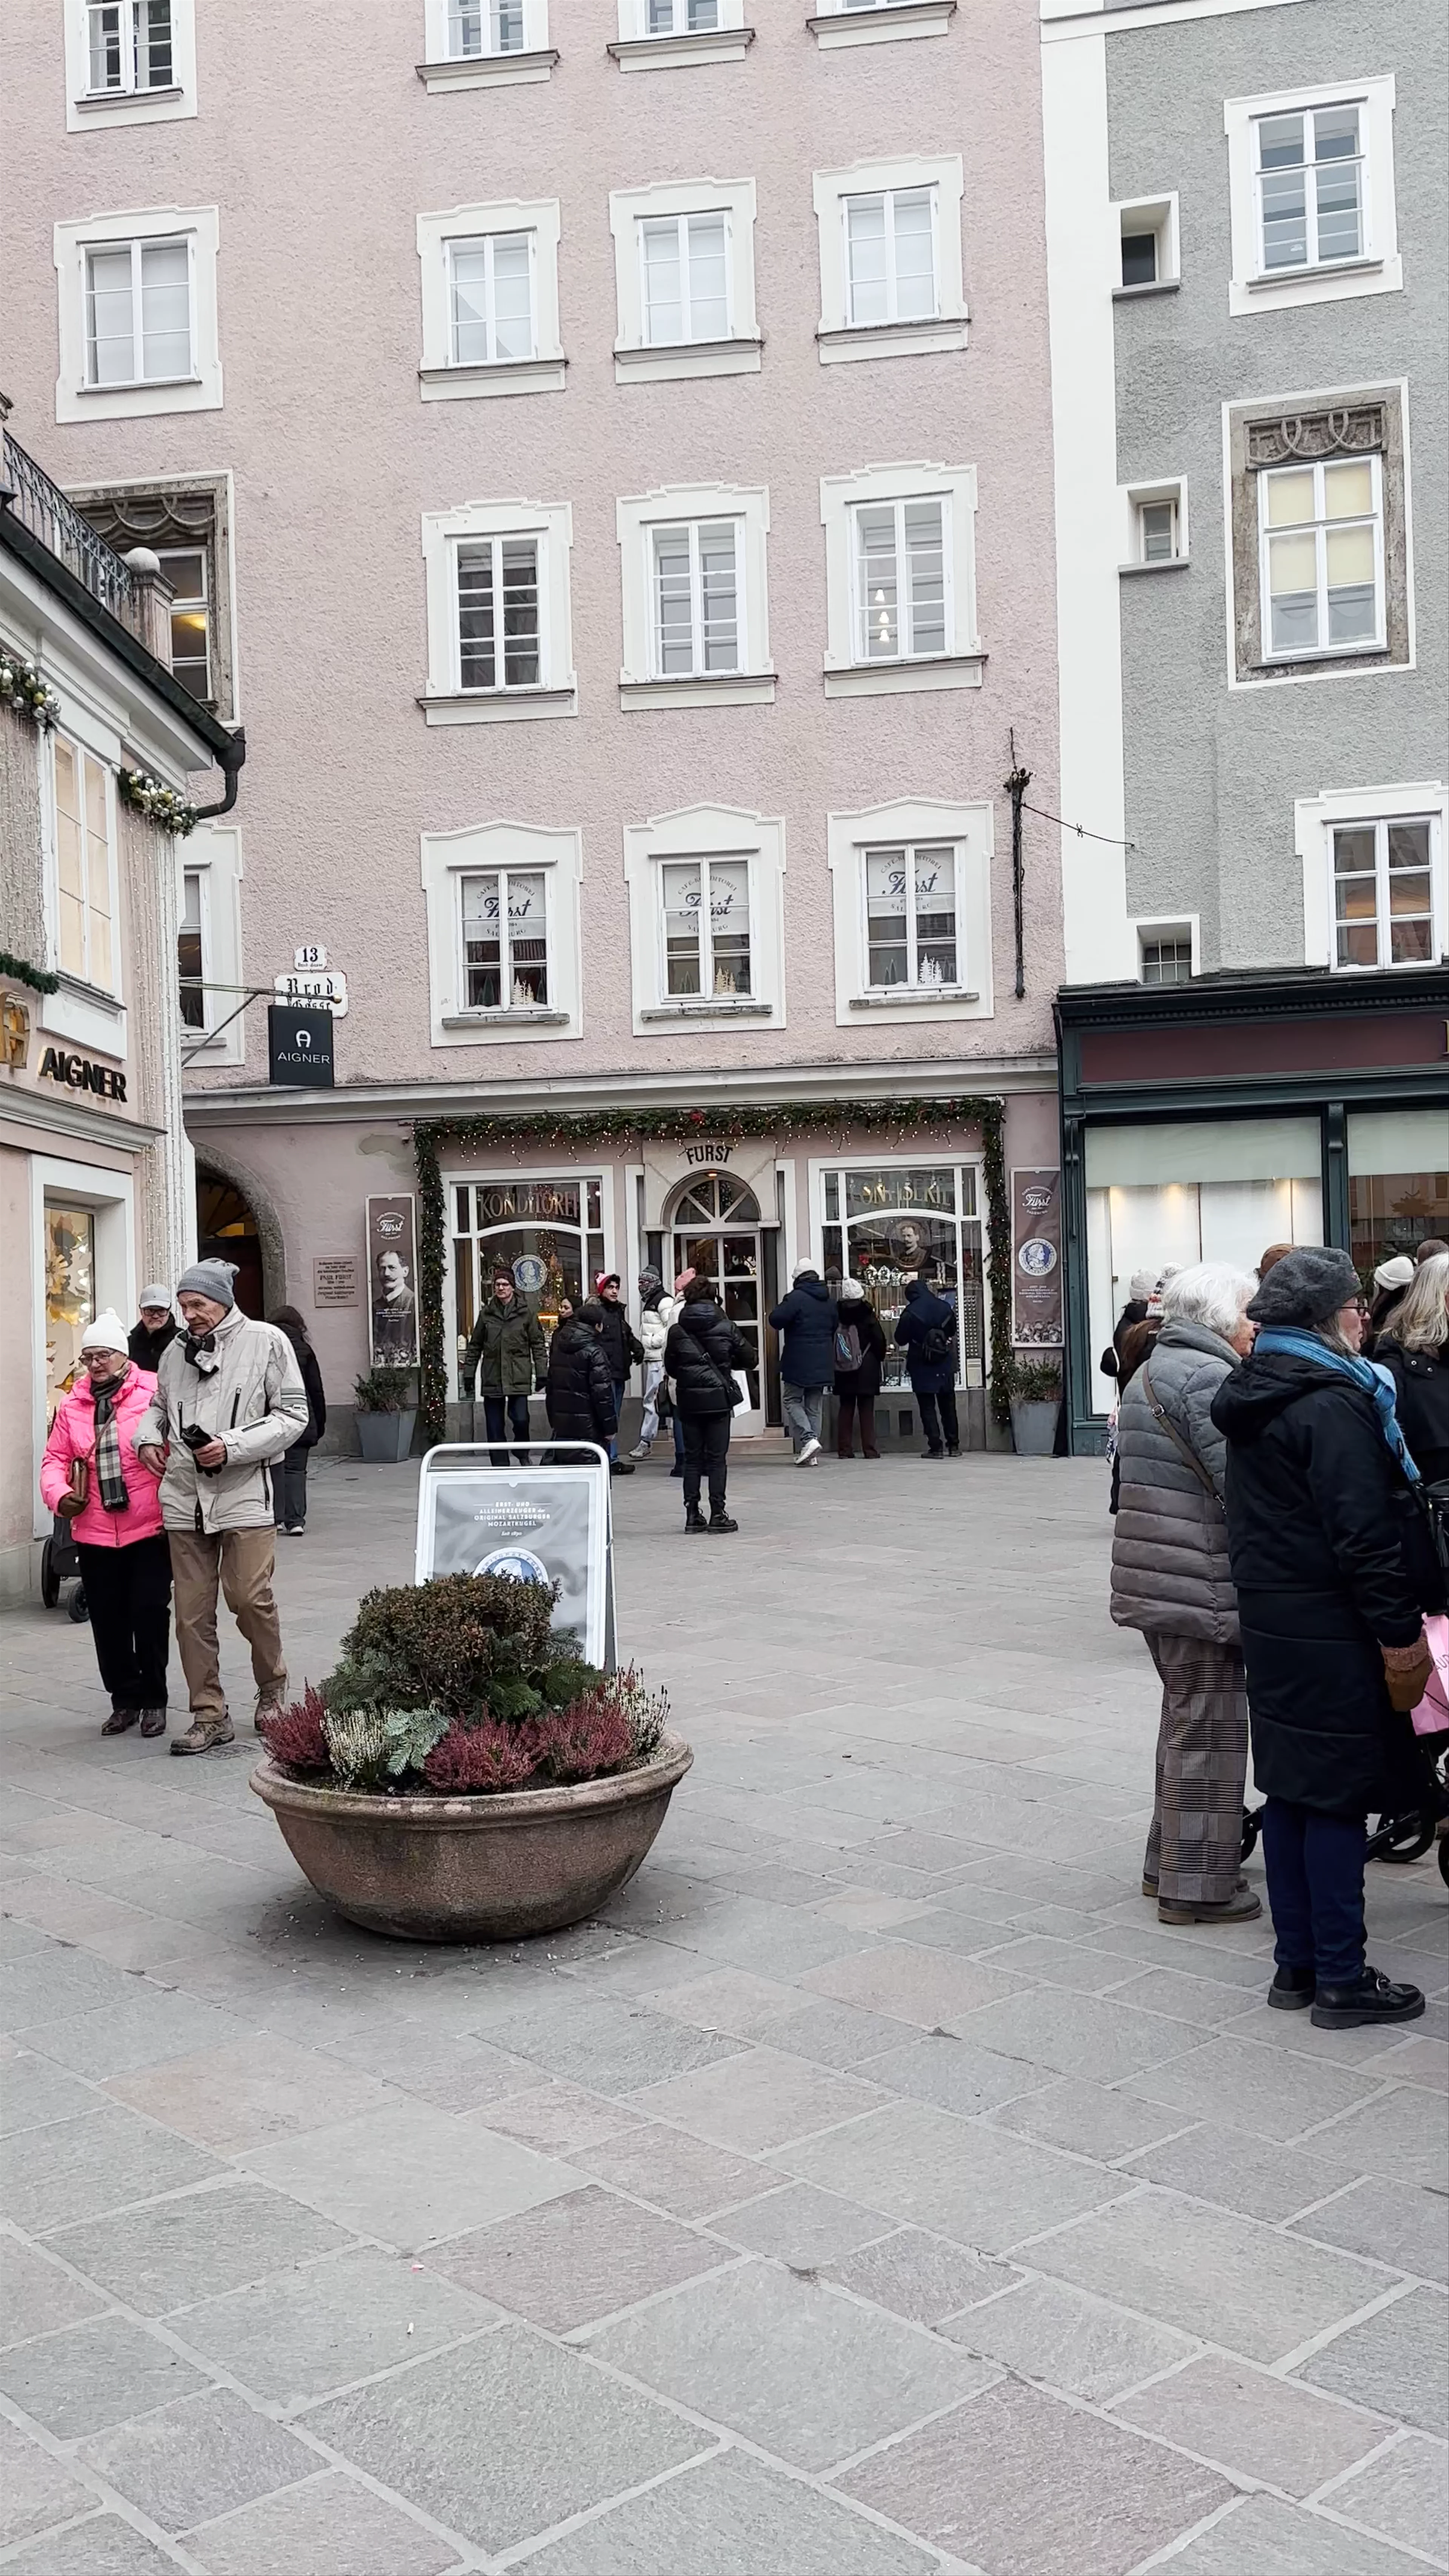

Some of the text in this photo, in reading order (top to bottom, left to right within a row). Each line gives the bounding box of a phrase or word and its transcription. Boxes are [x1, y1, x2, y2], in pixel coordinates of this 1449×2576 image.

[303, 947, 318, 962] 13
[277, 1052, 331, 1064] AIGNER
[40, 1047, 128, 1103] AIGNER
[480, 1191, 578, 1220] KONDITOREI
